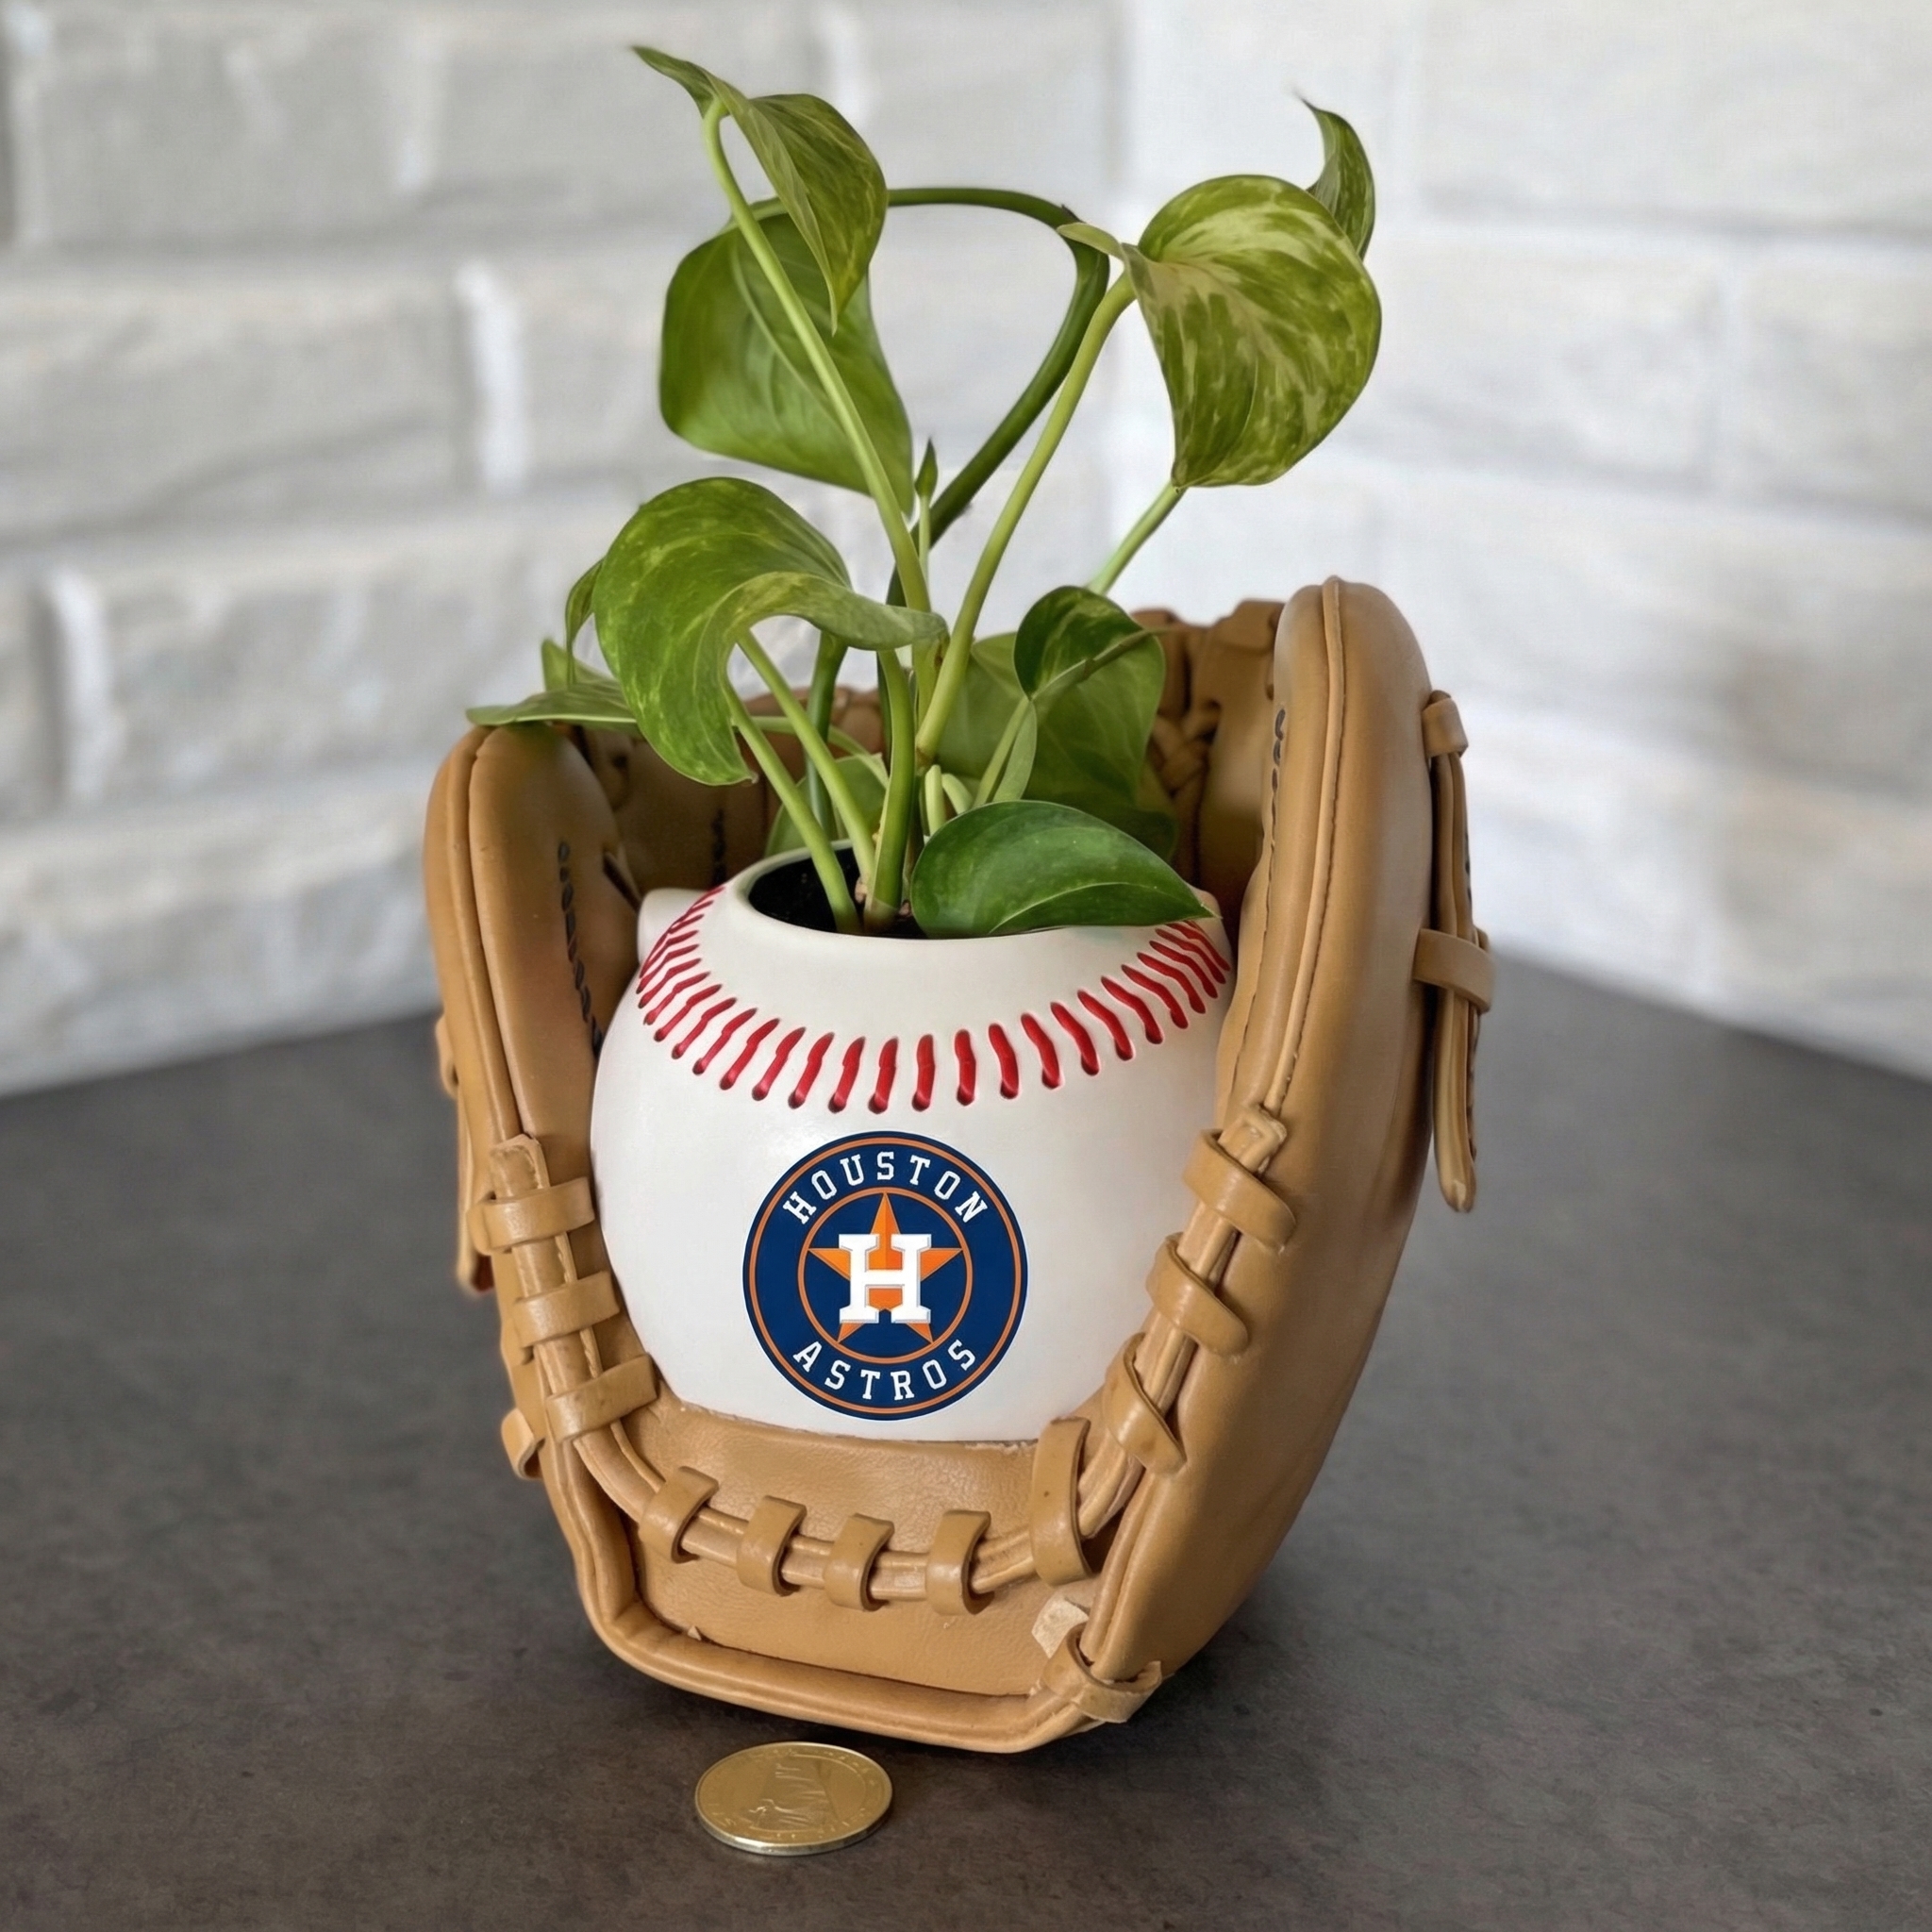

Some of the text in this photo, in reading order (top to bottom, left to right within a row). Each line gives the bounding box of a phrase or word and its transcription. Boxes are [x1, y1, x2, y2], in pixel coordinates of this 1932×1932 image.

[782, 1151, 988, 1224] HOUSTON
[839, 1233, 932, 1324] H
[792, 1339, 976, 1401] ASTROS
